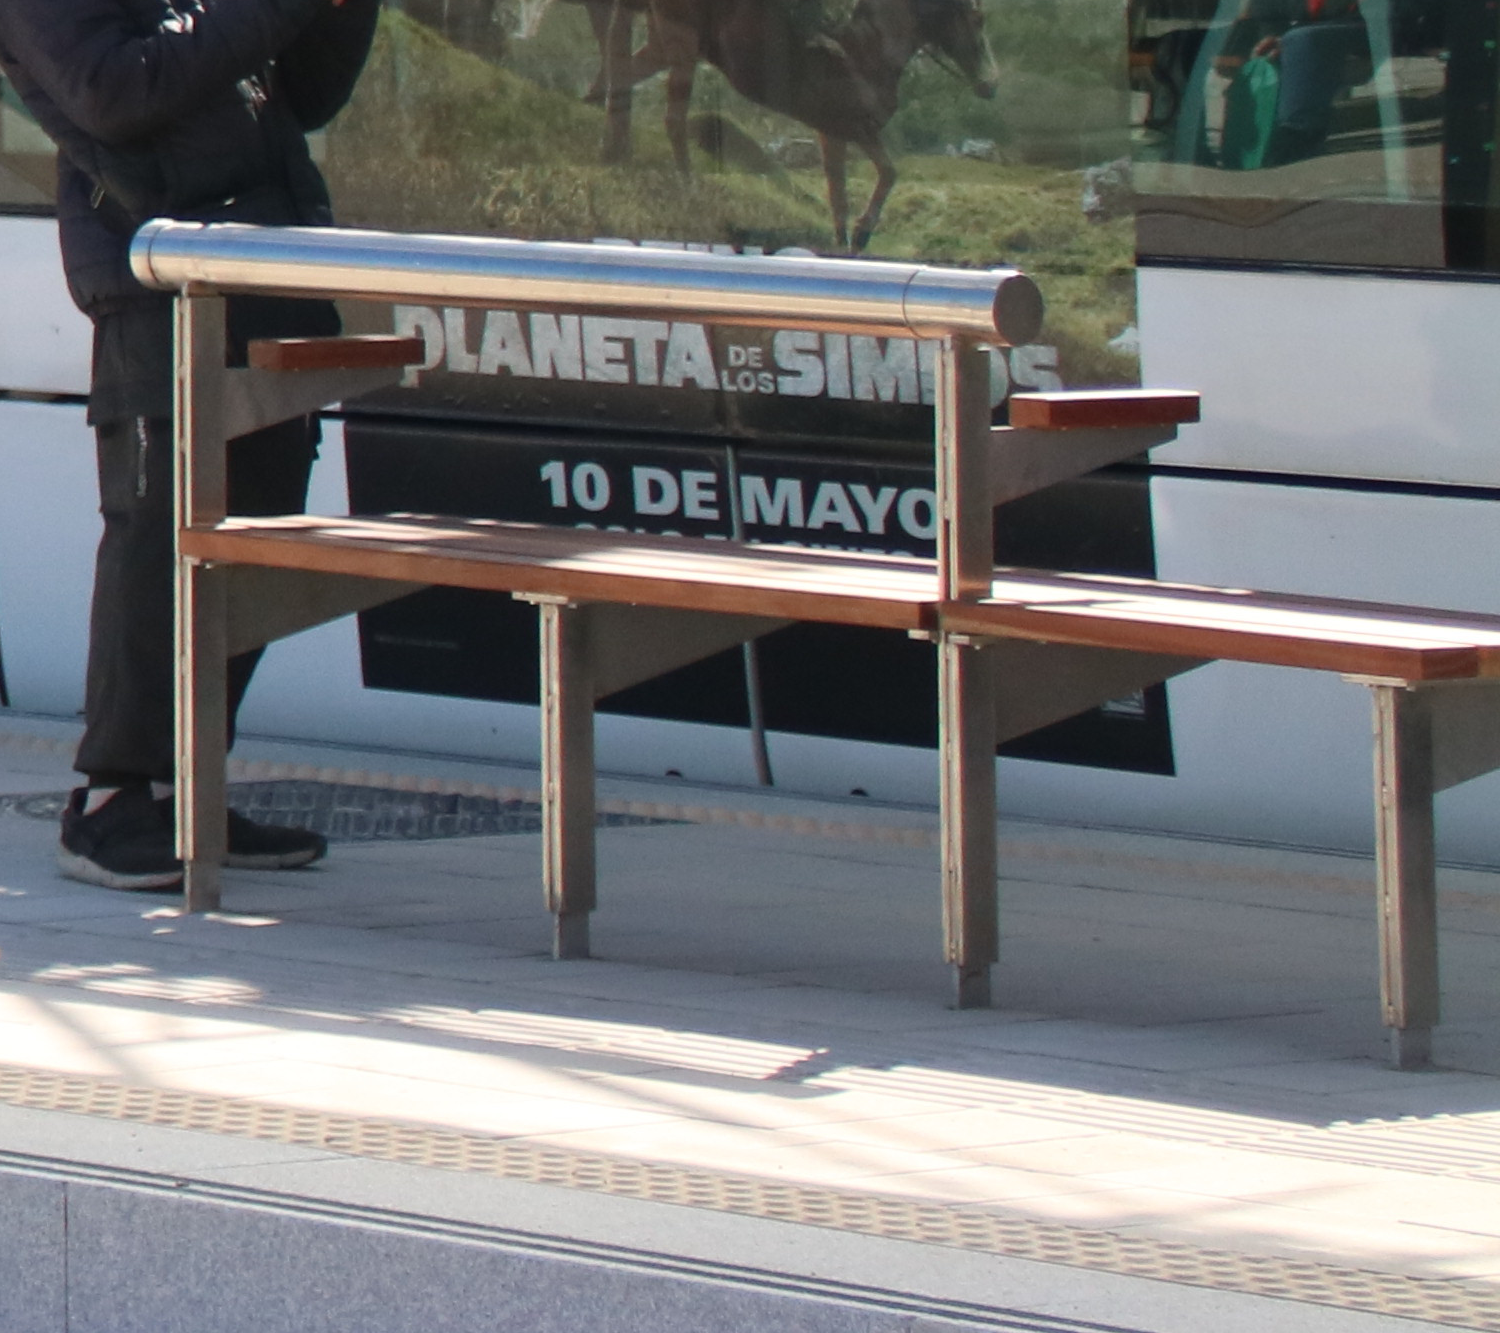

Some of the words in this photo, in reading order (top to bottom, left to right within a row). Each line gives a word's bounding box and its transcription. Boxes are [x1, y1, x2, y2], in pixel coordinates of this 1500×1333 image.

[391, 304, 723, 390] PLANETA
[728, 344, 764, 367] DE
[722, 368, 775, 395] LOS
[540, 459, 611, 512] 10
[631, 465, 720, 520] DE
[739, 476, 938, 540] MAYO
